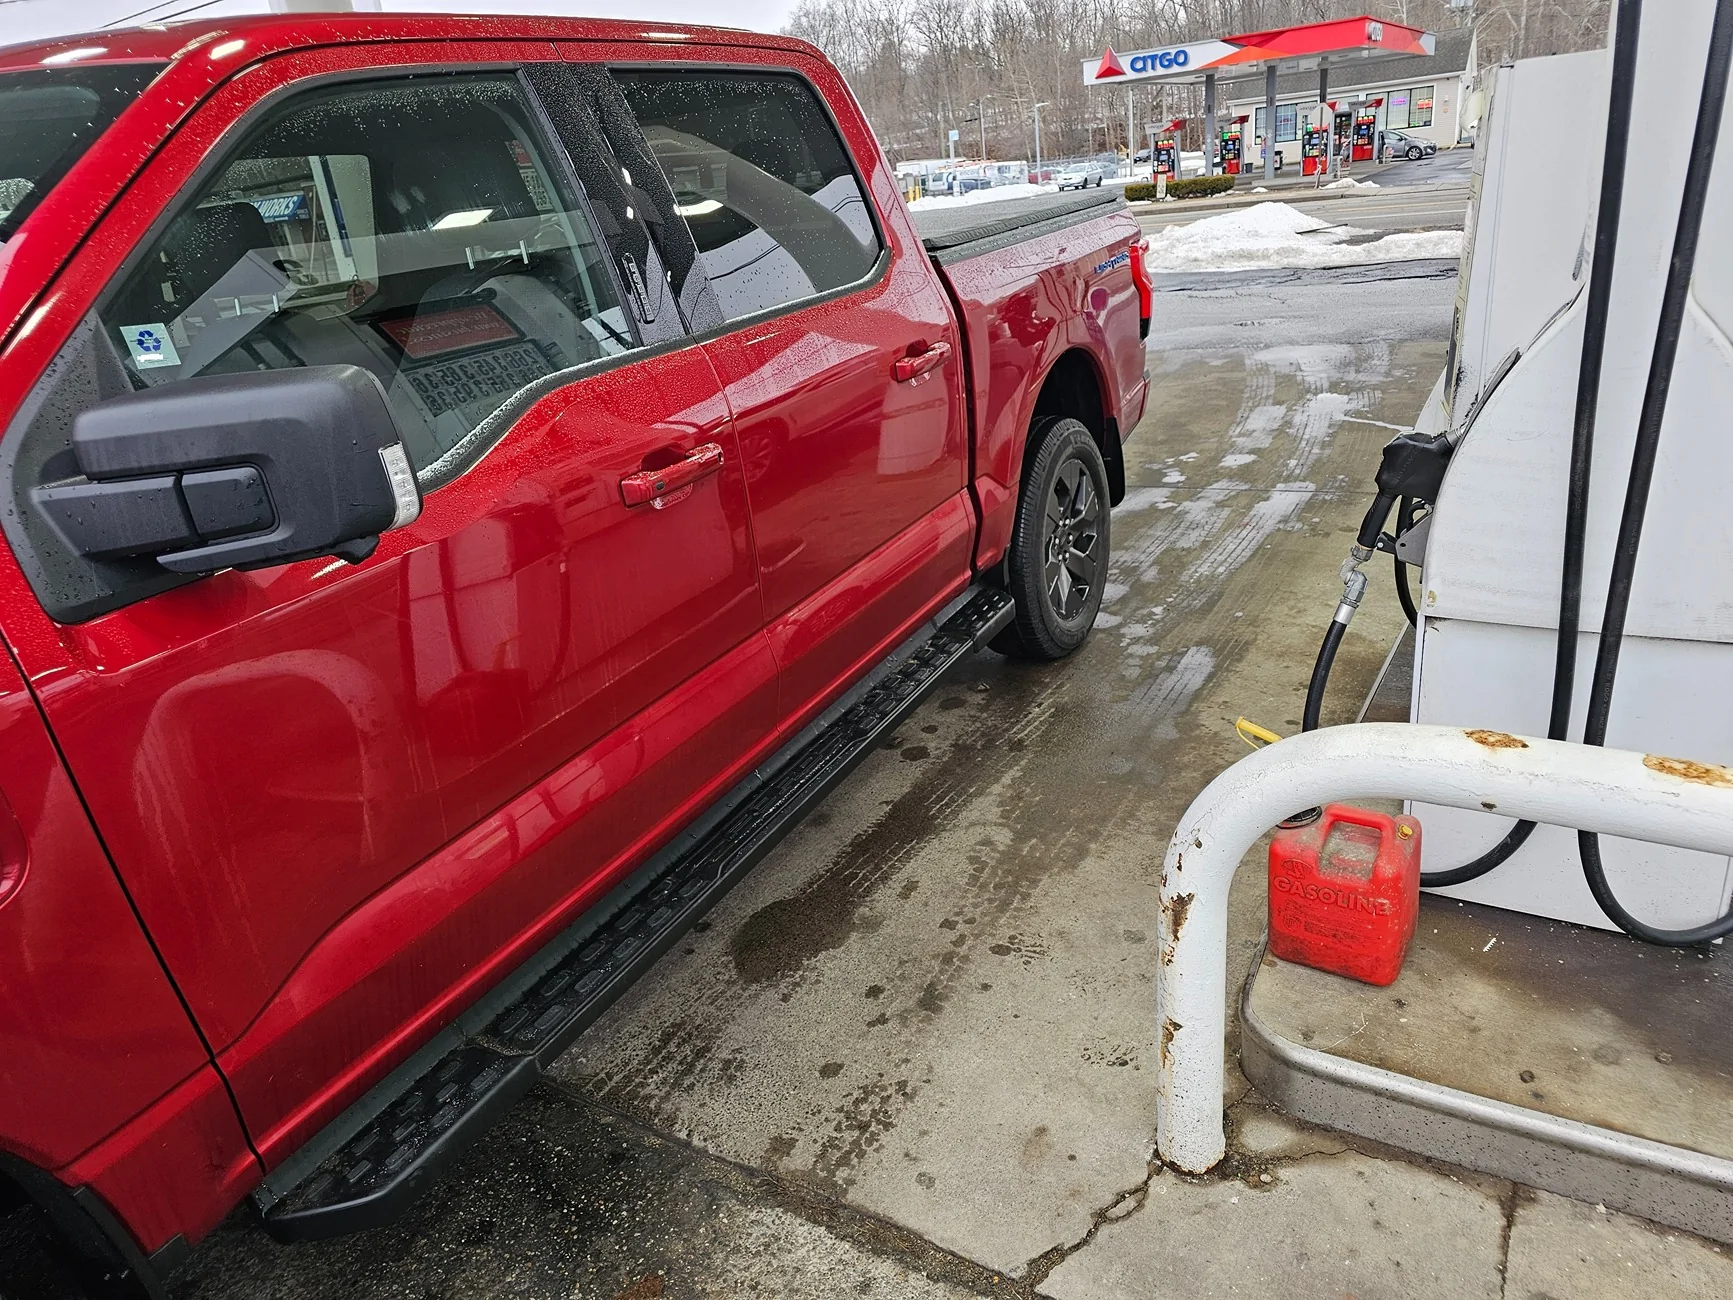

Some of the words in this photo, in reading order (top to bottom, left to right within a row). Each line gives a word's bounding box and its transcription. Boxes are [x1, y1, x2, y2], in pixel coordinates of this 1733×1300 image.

[1130, 49, 1188, 73] CITGO
[259, 196, 298, 217] WORKS
[1273, 876, 1390, 917] GASOLINE
